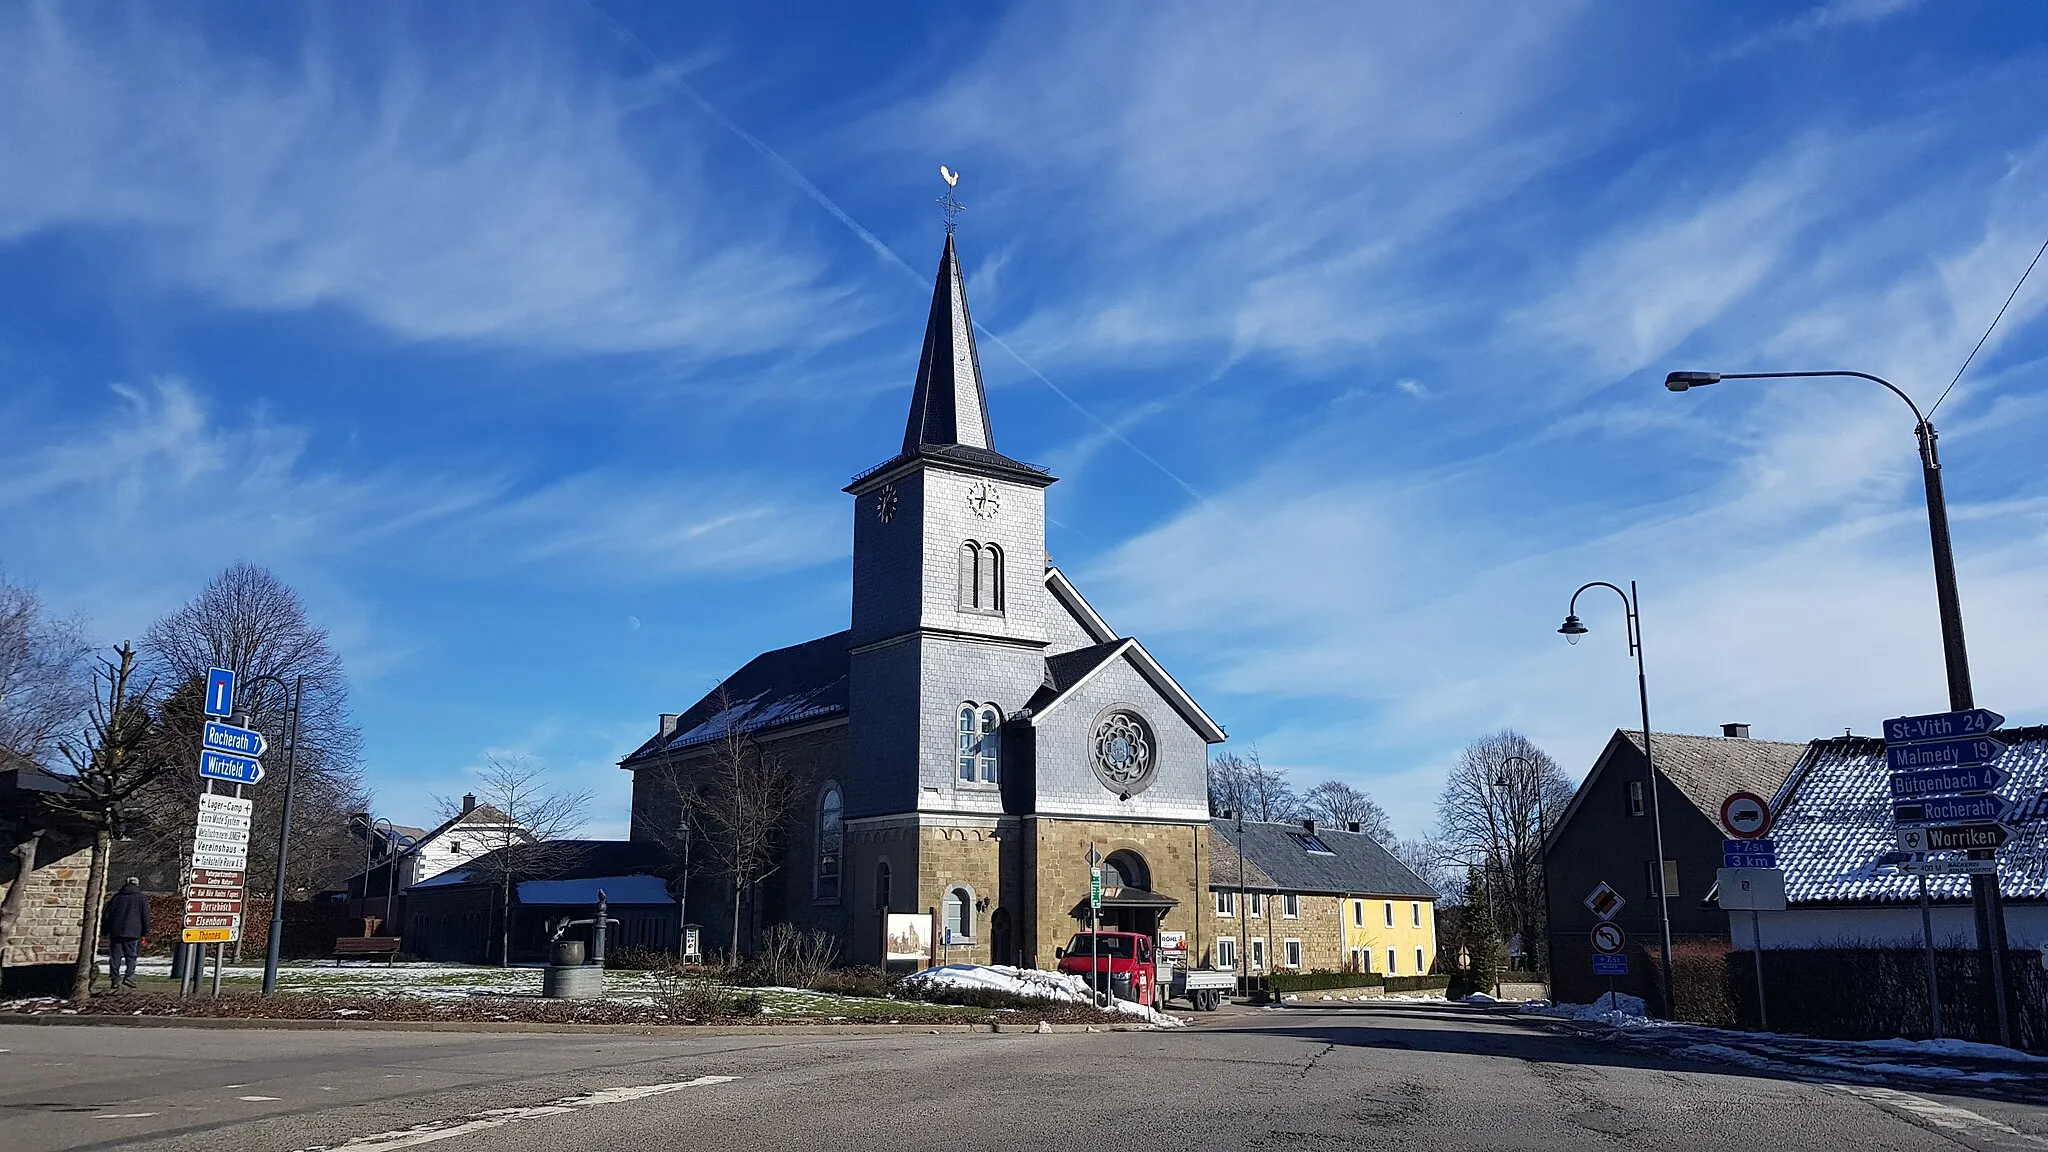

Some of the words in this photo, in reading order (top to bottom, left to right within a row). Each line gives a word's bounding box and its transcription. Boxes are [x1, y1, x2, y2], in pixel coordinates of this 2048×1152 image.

[1892, 718, 1952, 739] St-Vith
[1963, 714, 1985, 732] 24
[208, 727, 248, 750] Rocherath
[253, 736, 259, 752] 7
[1896, 746, 1958, 766] Malmedy
[1973, 742, 1988, 758] 19
[208, 756, 243, 778] Wirtzfeld
[250, 766, 256, 780] 2
[1896, 772, 1977, 796] Bütgenbach
[1984, 770, 1992, 786] 4
[207, 799, 242, 814] Lager-Camp
[1924, 798, 1995, 819] Rocherath
[197, 841, 236, 854] Vereinshaus
[1929, 829, 1996, 847] Worriken
[1732, 856, 1741, 866] 3
[1746, 856, 1768, 867] km
[196, 916, 227, 926] Elsenborn
